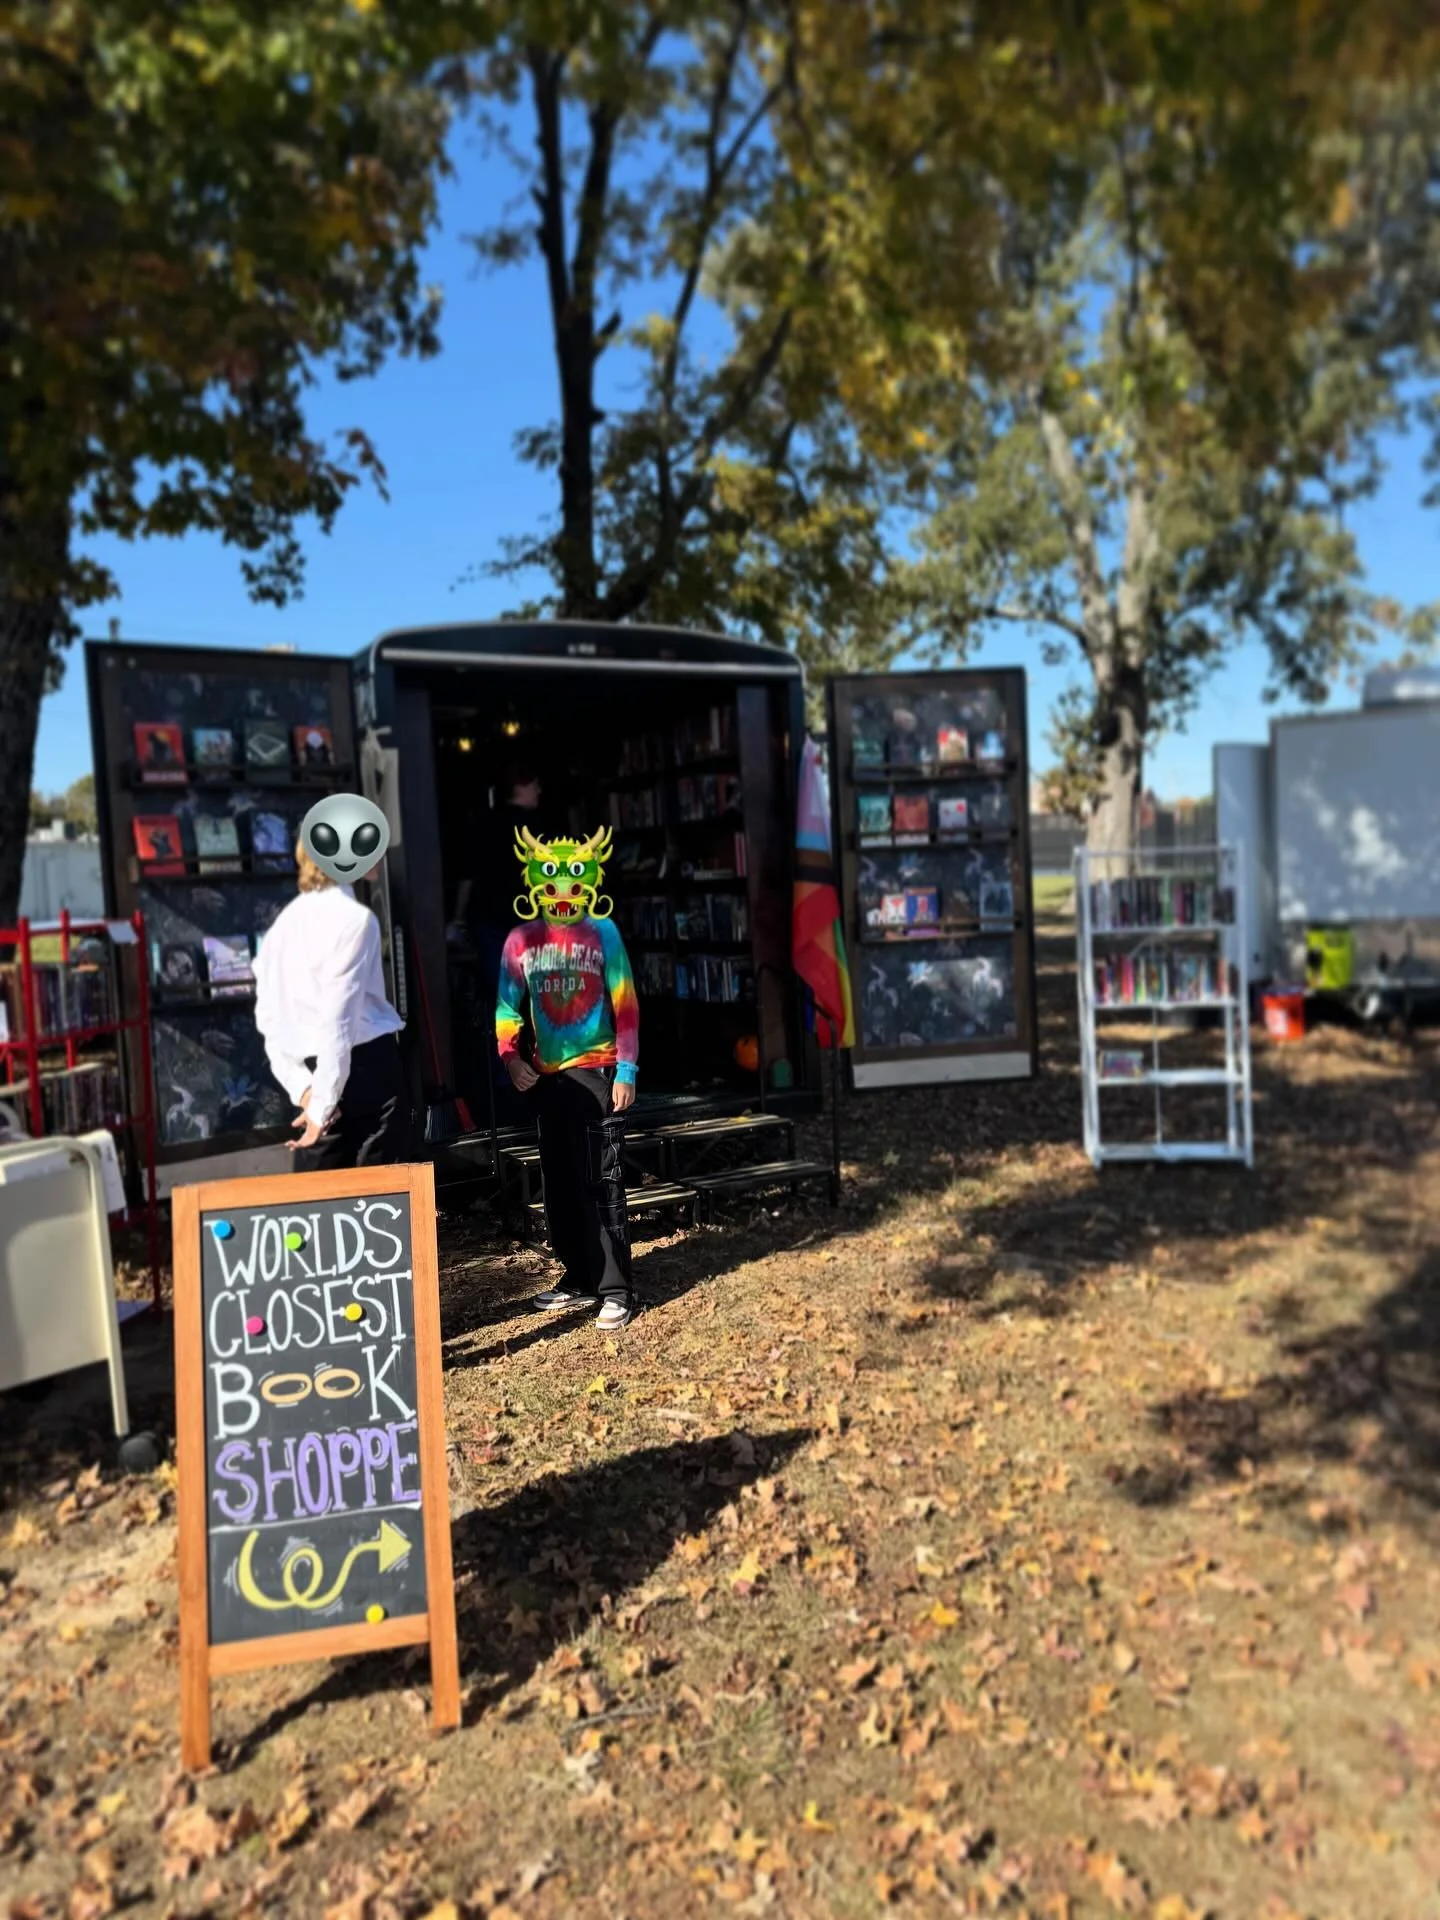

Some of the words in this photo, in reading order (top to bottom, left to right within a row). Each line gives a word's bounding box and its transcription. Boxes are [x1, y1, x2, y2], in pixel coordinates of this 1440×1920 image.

[203, 1200, 402, 1287] WORLD'S
[209, 1270, 412, 1357] CLOSEST
[210, 1344, 416, 1440] BOOK
[213, 1419, 421, 1522] SHOPPE
